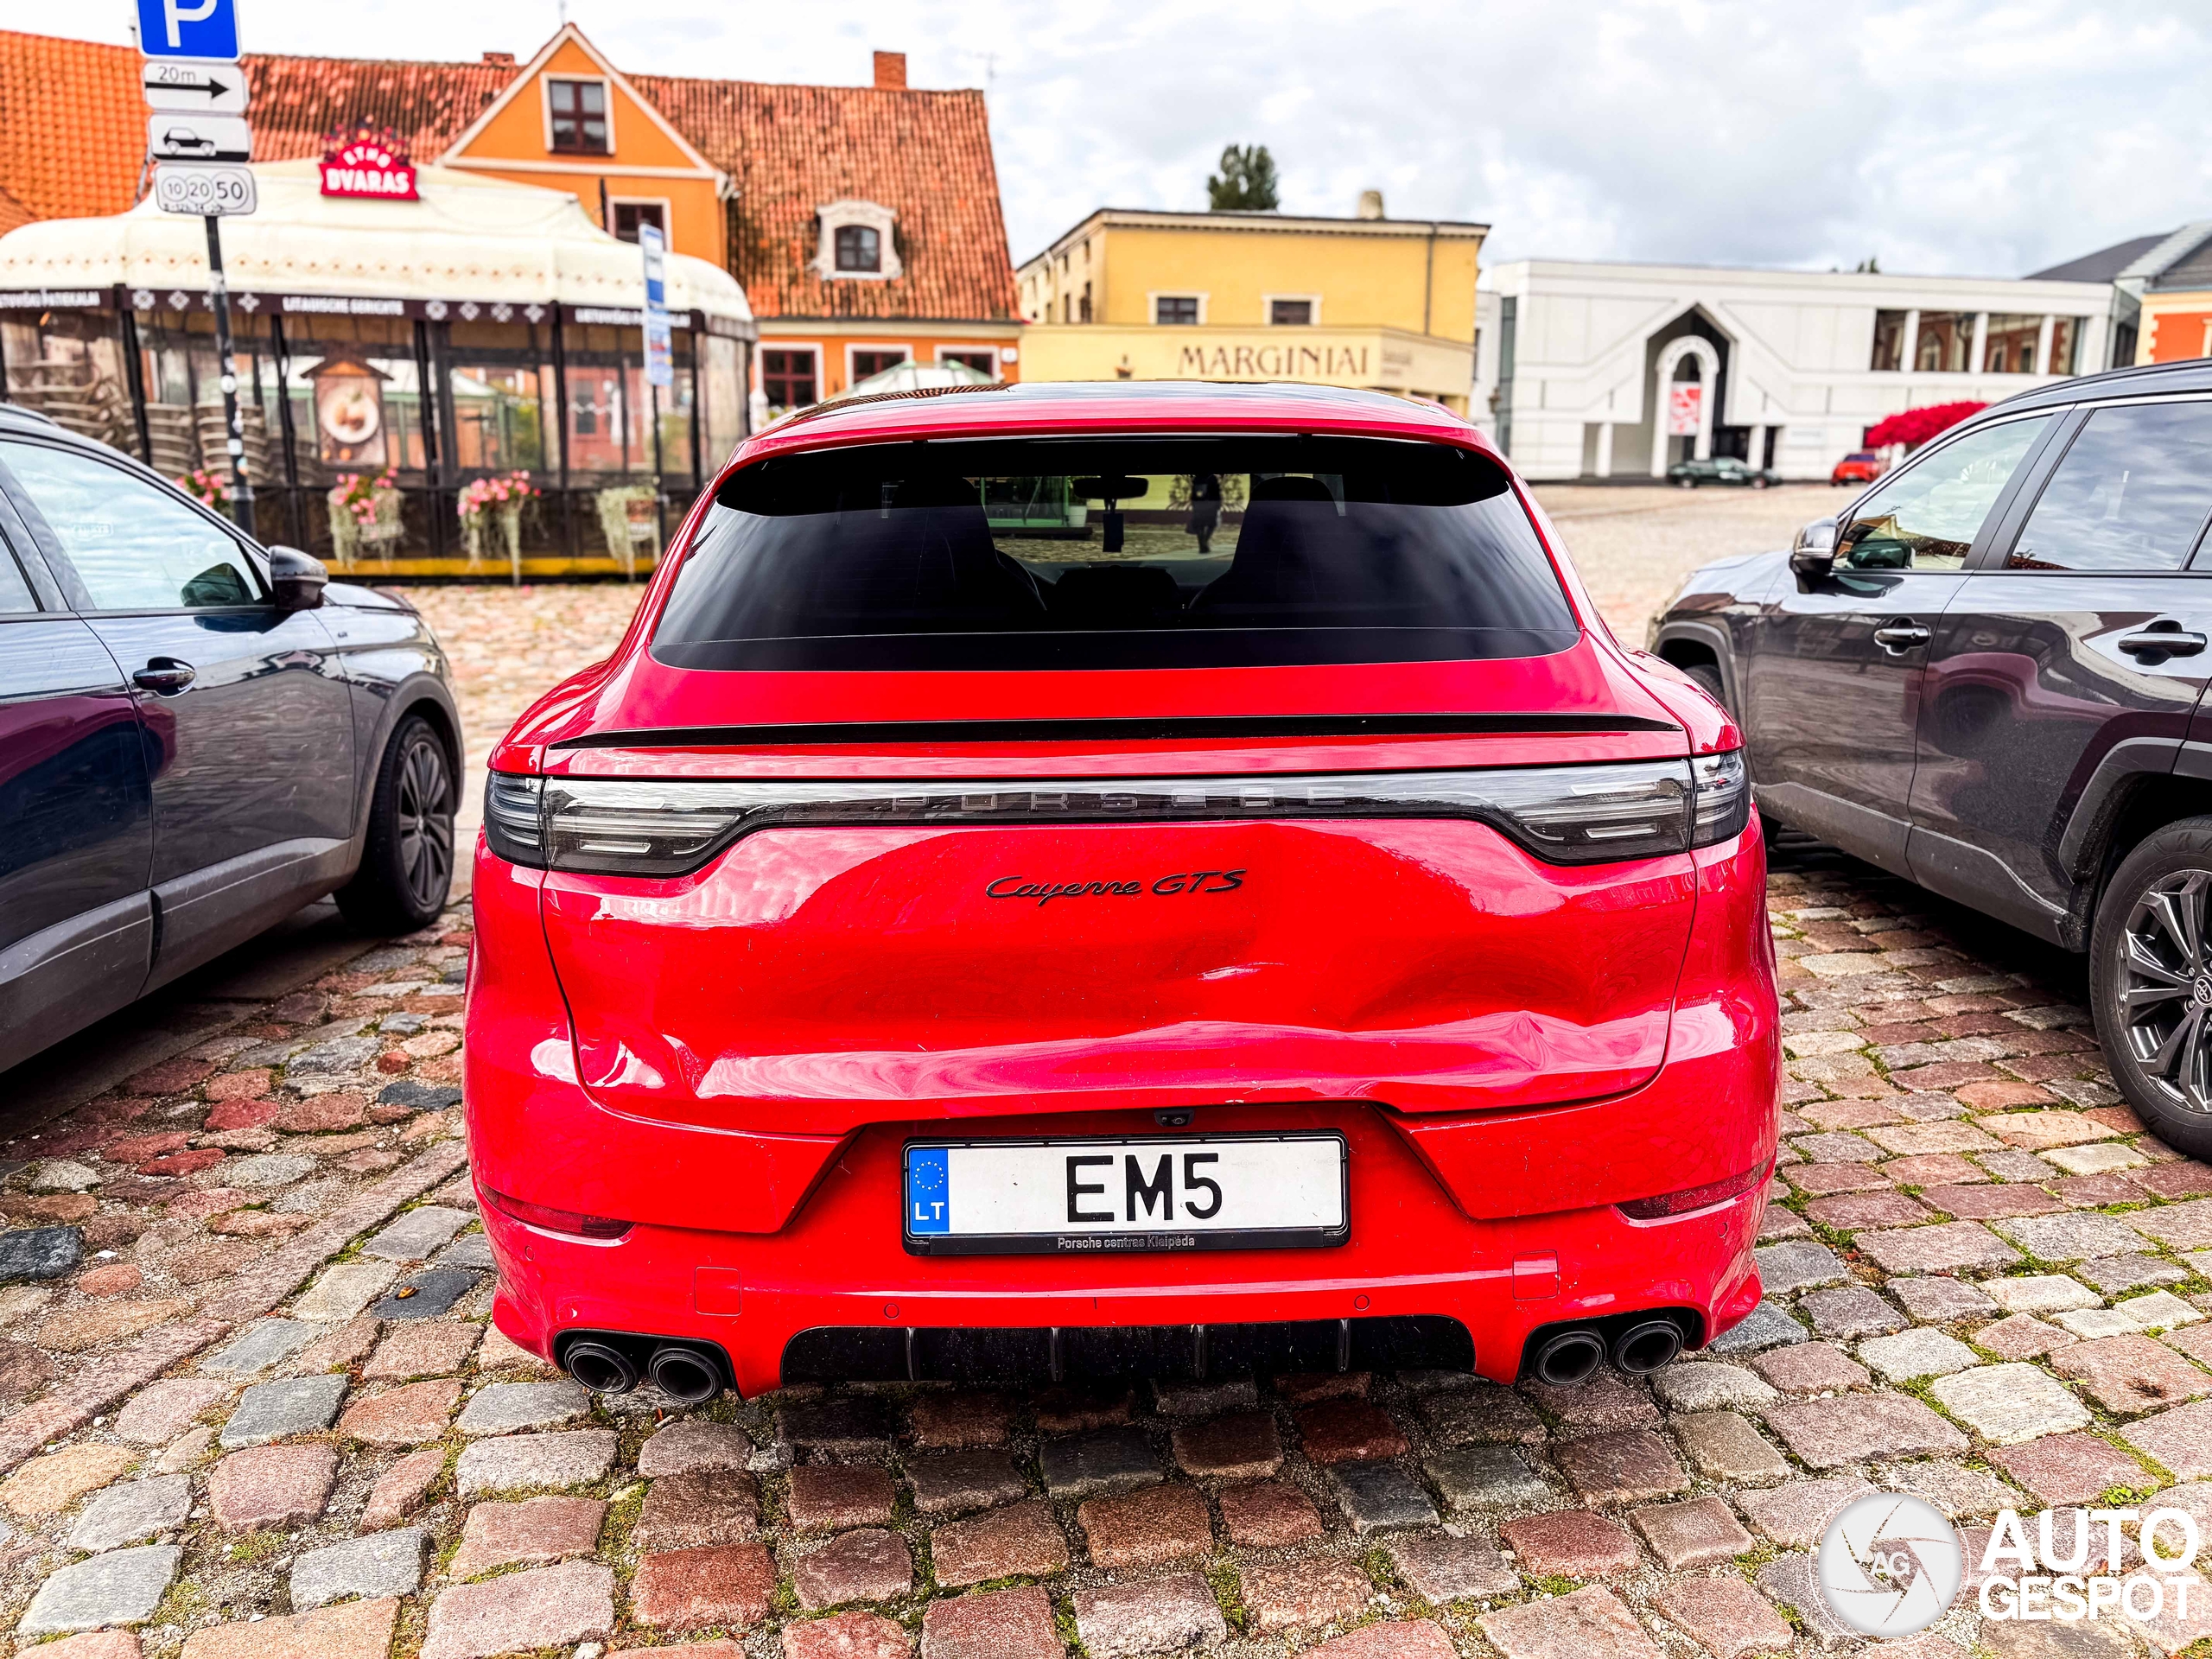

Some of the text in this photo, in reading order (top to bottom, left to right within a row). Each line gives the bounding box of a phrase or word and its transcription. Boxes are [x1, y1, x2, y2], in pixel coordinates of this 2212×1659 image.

[163, 0, 218, 48] P
[168, 181, 244, 200] 10 20 50
[326, 168, 410, 194] DVARAS
[1178, 346, 1368, 375] MARGINIAI
[893, 785, 1346, 812] PORSCHE
[986, 868, 1247, 907] Cayenne GTS
[1066, 1152, 1223, 1223] EM5
[915, 1201, 945, 1221] LT
[1058, 1236, 1102, 1249] Porsche
